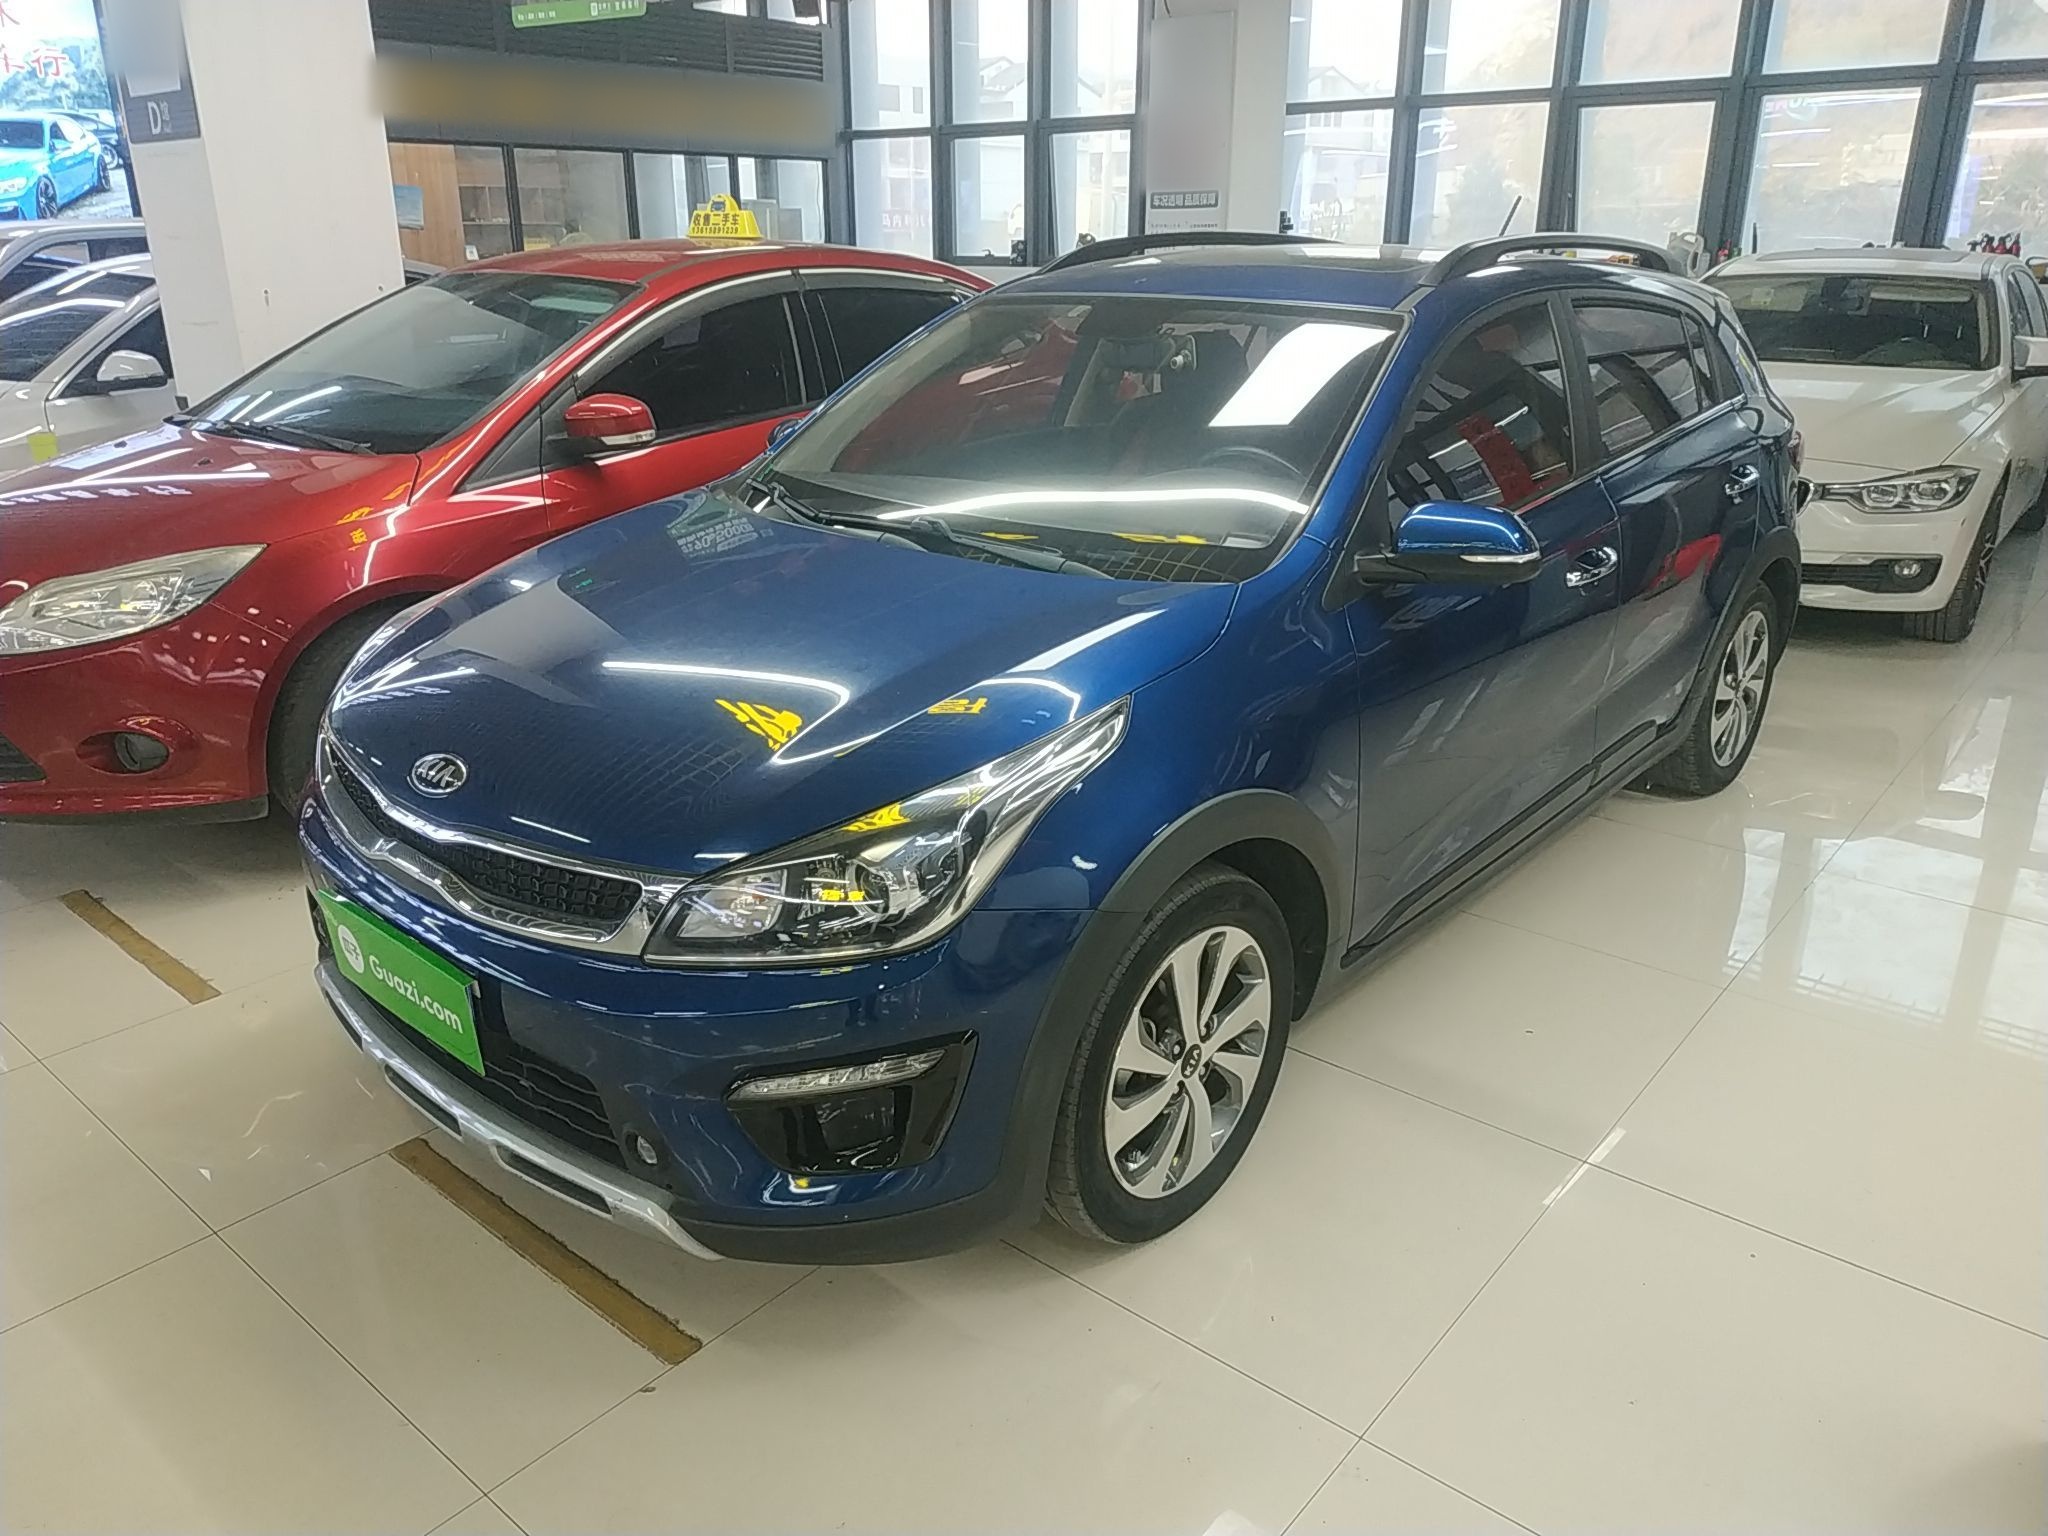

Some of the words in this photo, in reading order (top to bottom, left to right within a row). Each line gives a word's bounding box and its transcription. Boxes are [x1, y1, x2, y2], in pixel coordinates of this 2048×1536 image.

[416, 759, 456, 788] KIA
[369, 954, 463, 1035] Guazi.com
[1184, 1049, 1200, 1076] KIA
